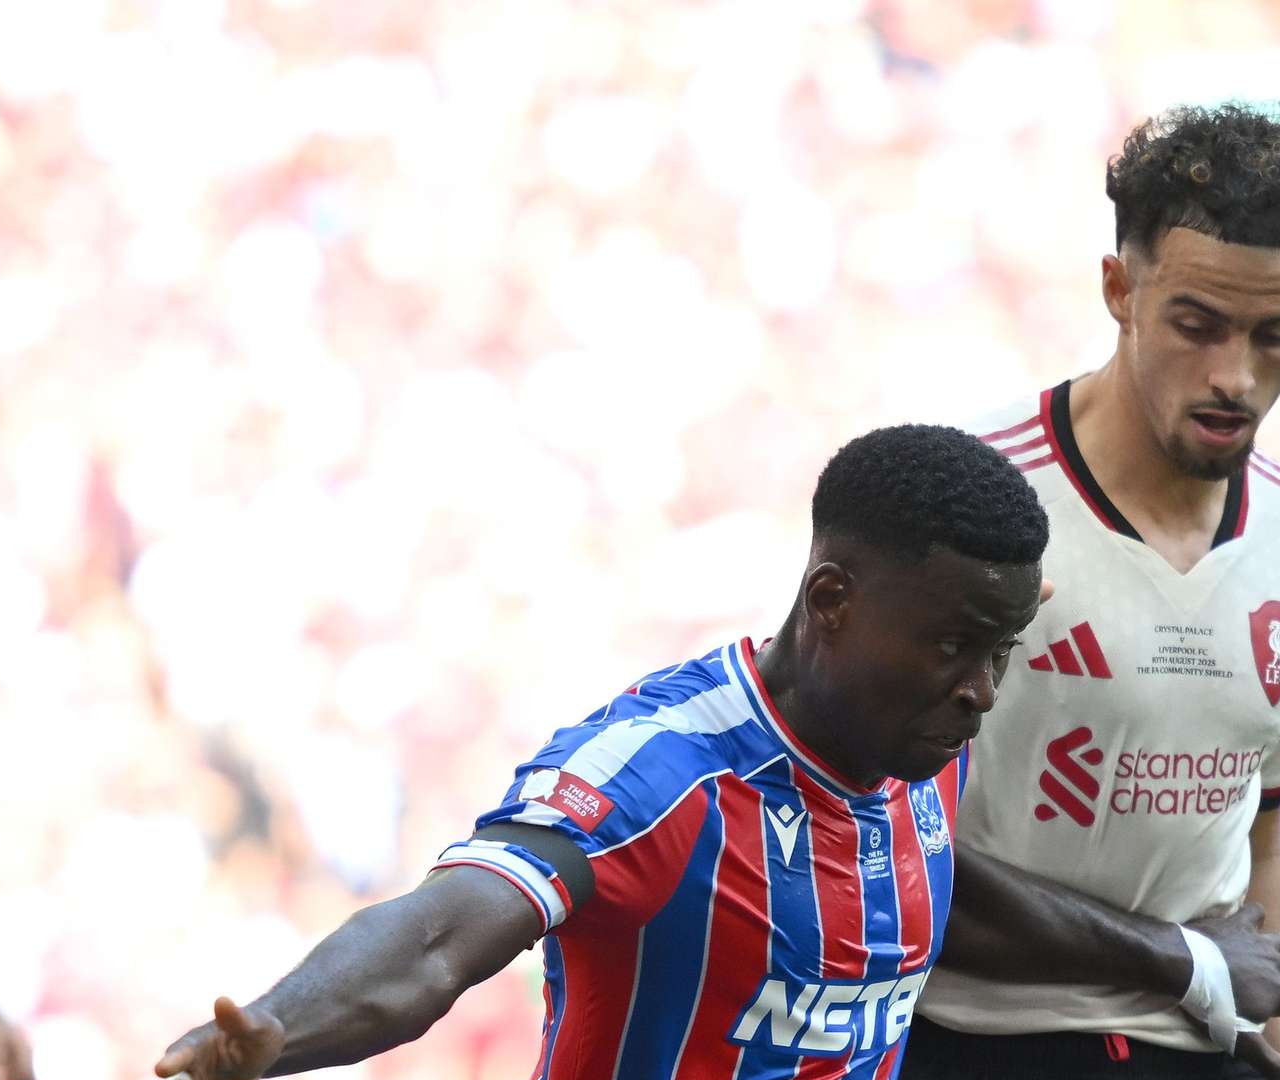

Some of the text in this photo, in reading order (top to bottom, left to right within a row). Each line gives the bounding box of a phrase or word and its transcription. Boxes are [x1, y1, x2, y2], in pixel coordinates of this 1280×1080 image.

[1154, 624, 1215, 637] CRYSTAL PALACE
[1158, 646, 1209, 657] LIVERPOOL FC
[1169, 657, 1196, 666] AUGUST
[1197, 658, 1217, 667] 2025
[1137, 666, 1150, 675] THE
[1160, 667, 1204, 676] COMMUNITY
[1205, 669, 1233, 679] SHIELD
[1114, 745, 1267, 780] standard
[558, 788, 600, 818] COMMUNITY
[567, 783, 601, 811] THE FA
[562, 798, 587, 817] SHIELD
[733, 967, 932, 1051] NET8
